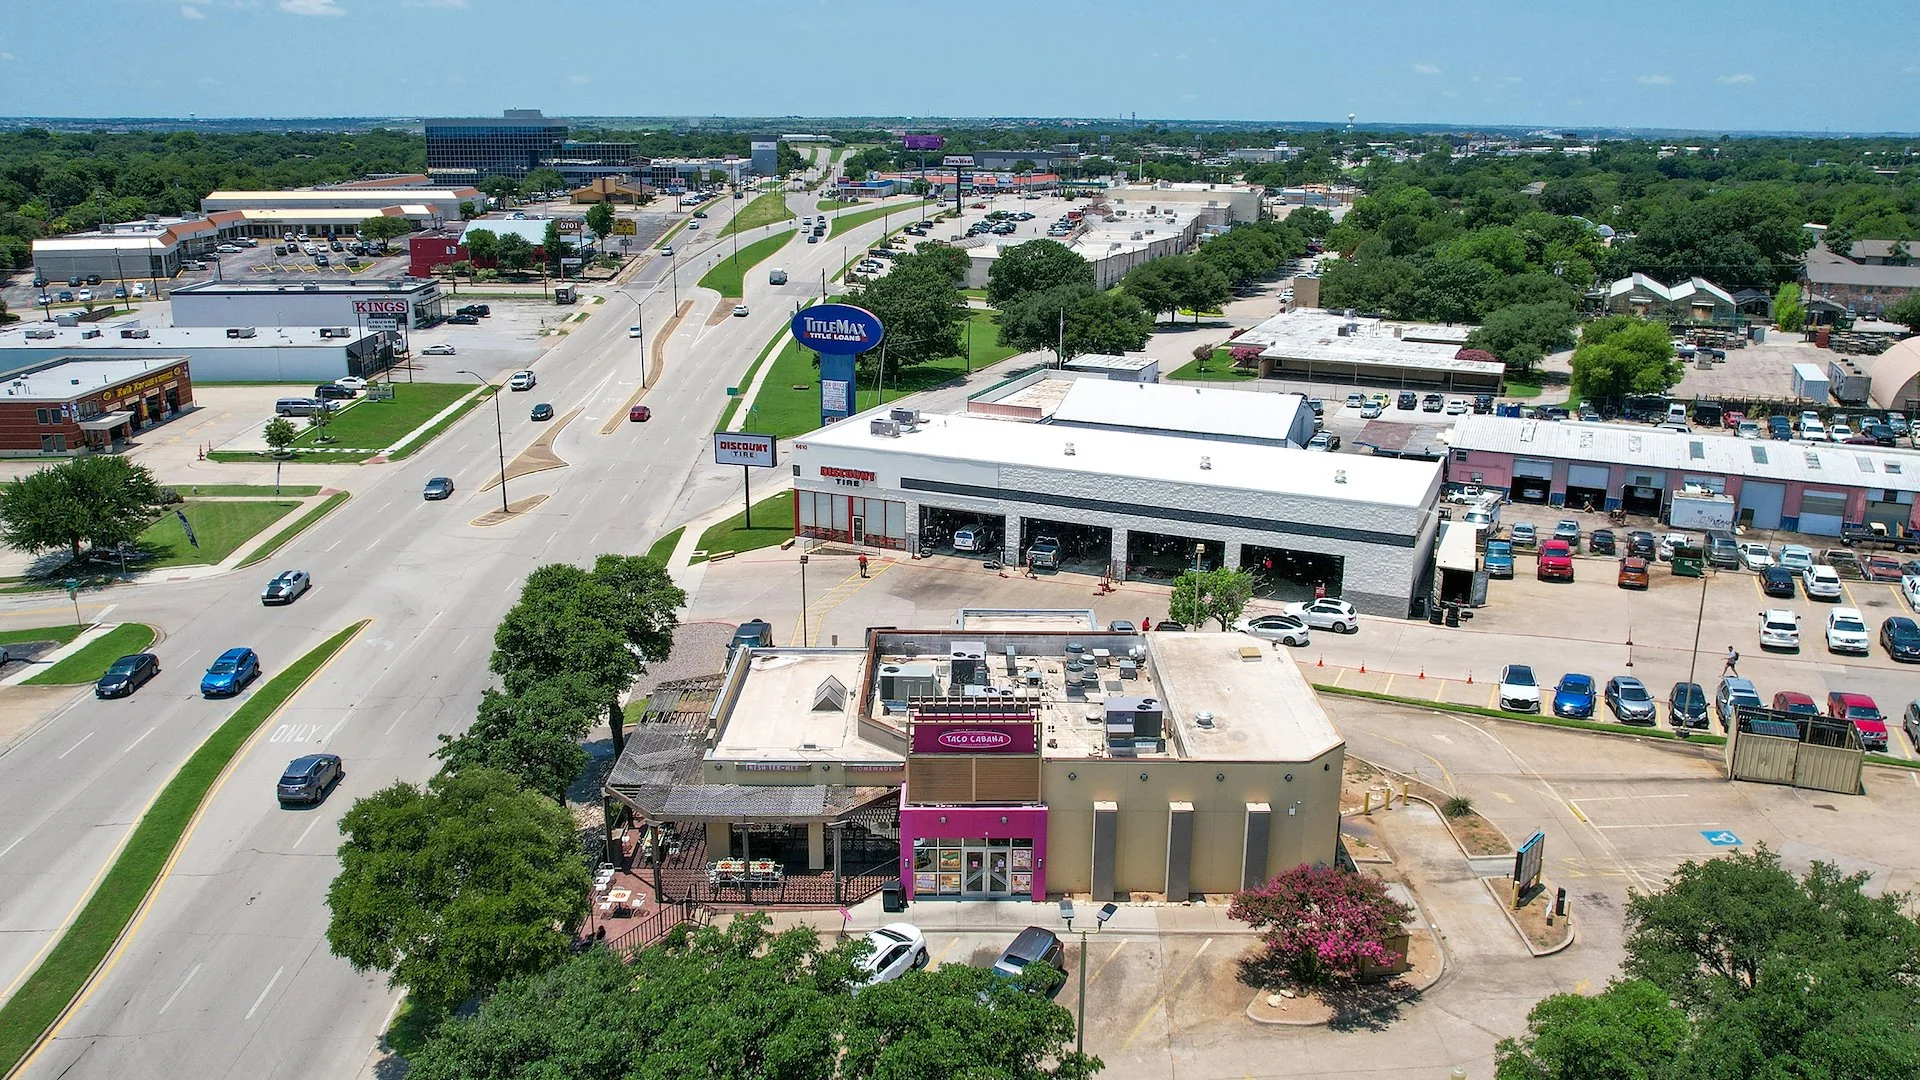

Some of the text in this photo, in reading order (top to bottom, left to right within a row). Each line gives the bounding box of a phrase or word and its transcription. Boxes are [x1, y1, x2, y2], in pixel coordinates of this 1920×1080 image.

[355, 302, 406, 312] KINGS
[810, 332, 861, 342] TITLE LOANS
[720, 441, 768, 452] DISCOUNT
[820, 466, 875, 481] DISCOUNT
[835, 478, 860, 487] TIRE
[270, 724, 324, 742] ONLY
[946, 735, 1004, 743] TACO CABANA
